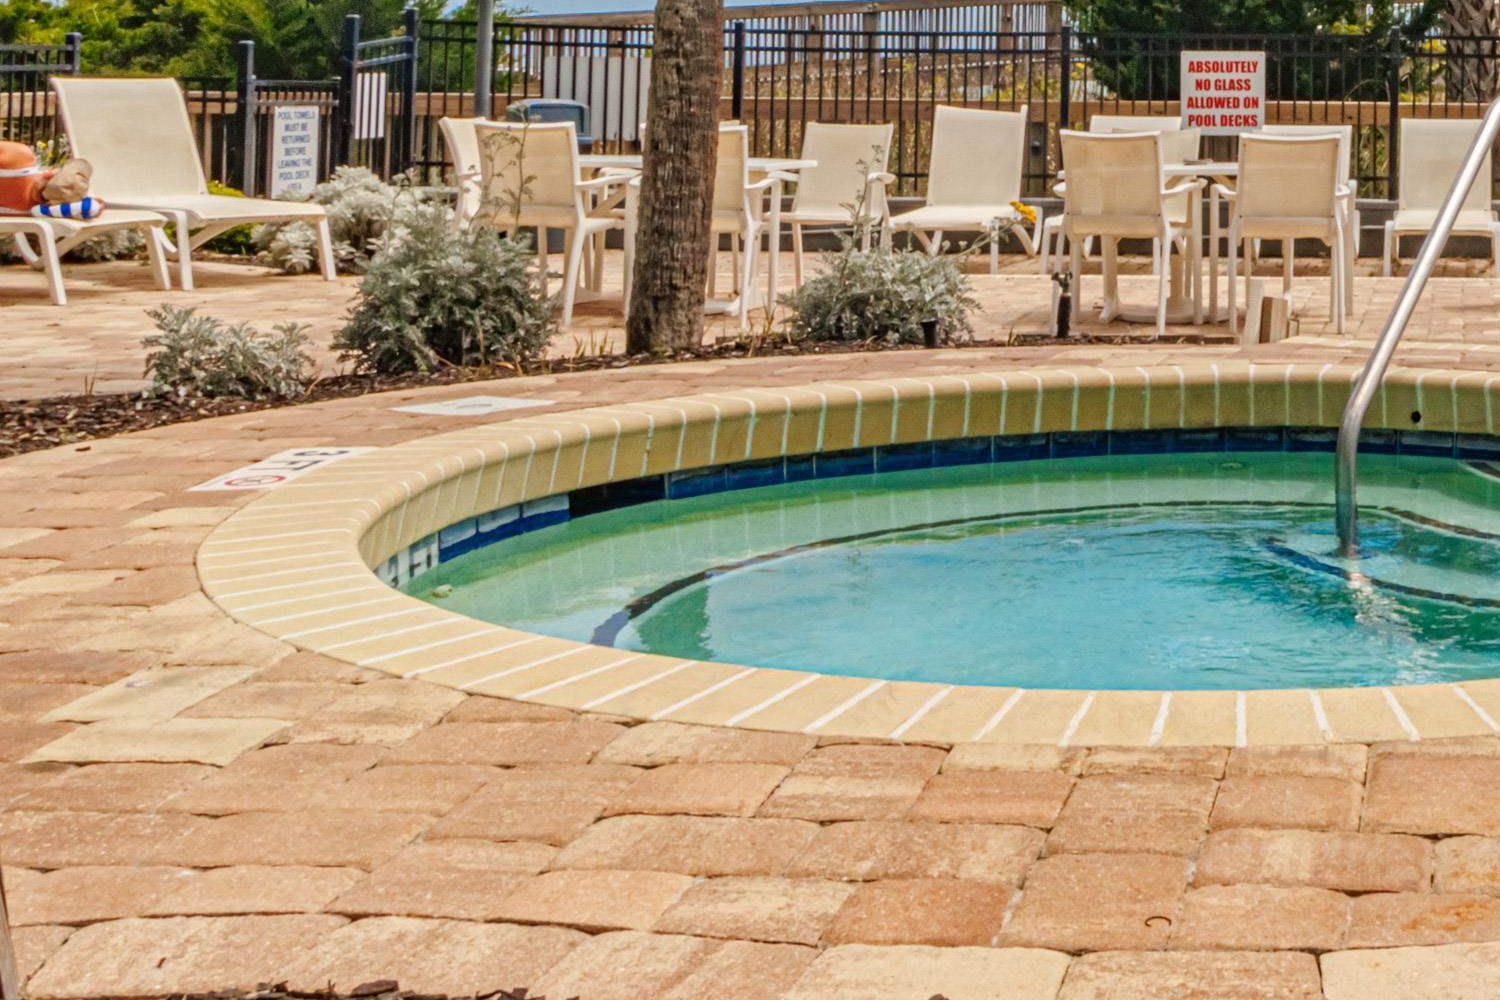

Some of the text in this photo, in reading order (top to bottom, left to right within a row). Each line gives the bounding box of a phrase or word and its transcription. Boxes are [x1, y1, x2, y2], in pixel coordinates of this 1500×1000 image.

[1188, 61, 1258, 73] ABSOLUTELY
[1195, 79, 1251, 91] NO GLASS
[1187, 97, 1259, 109] ALLOWED ON
[1188, 115, 1258, 127] POOL DECKS
